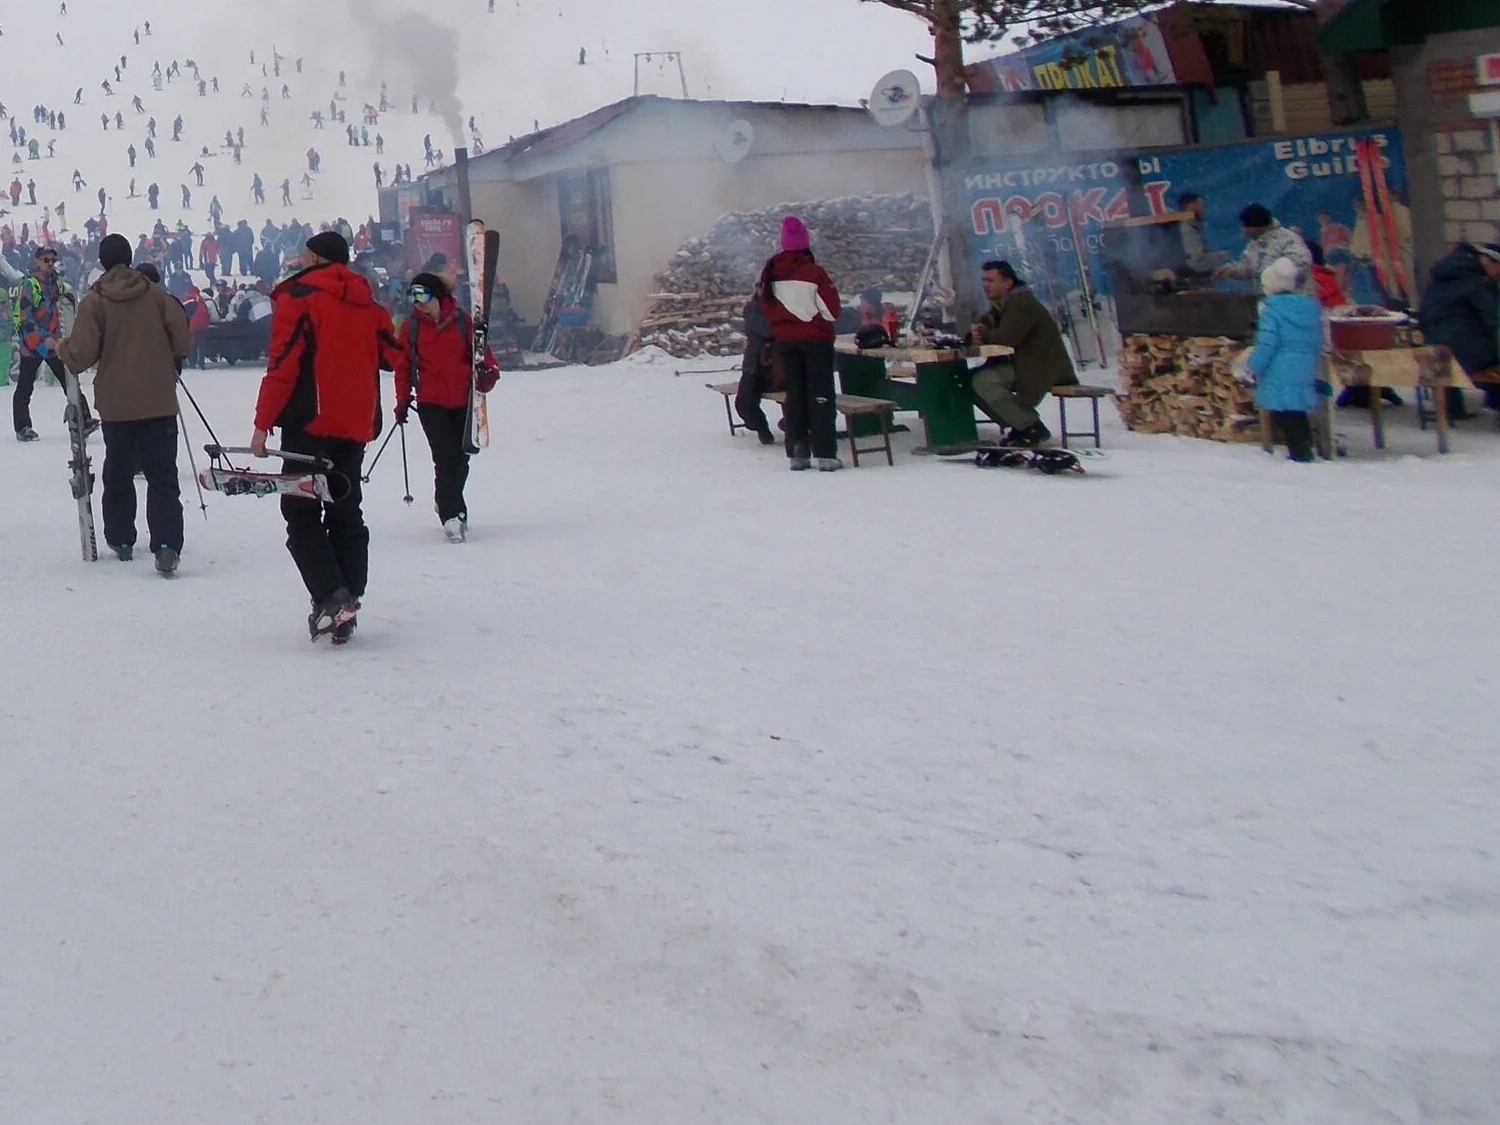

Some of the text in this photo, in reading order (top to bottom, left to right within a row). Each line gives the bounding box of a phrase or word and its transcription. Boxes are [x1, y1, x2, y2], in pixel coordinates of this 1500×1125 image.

[1033, 44, 1124, 90] ПРОКАТ
[965, 156, 1161, 190] ИНСТРУКТОЫ
[971, 181, 1171, 232] ПРОКАТ
